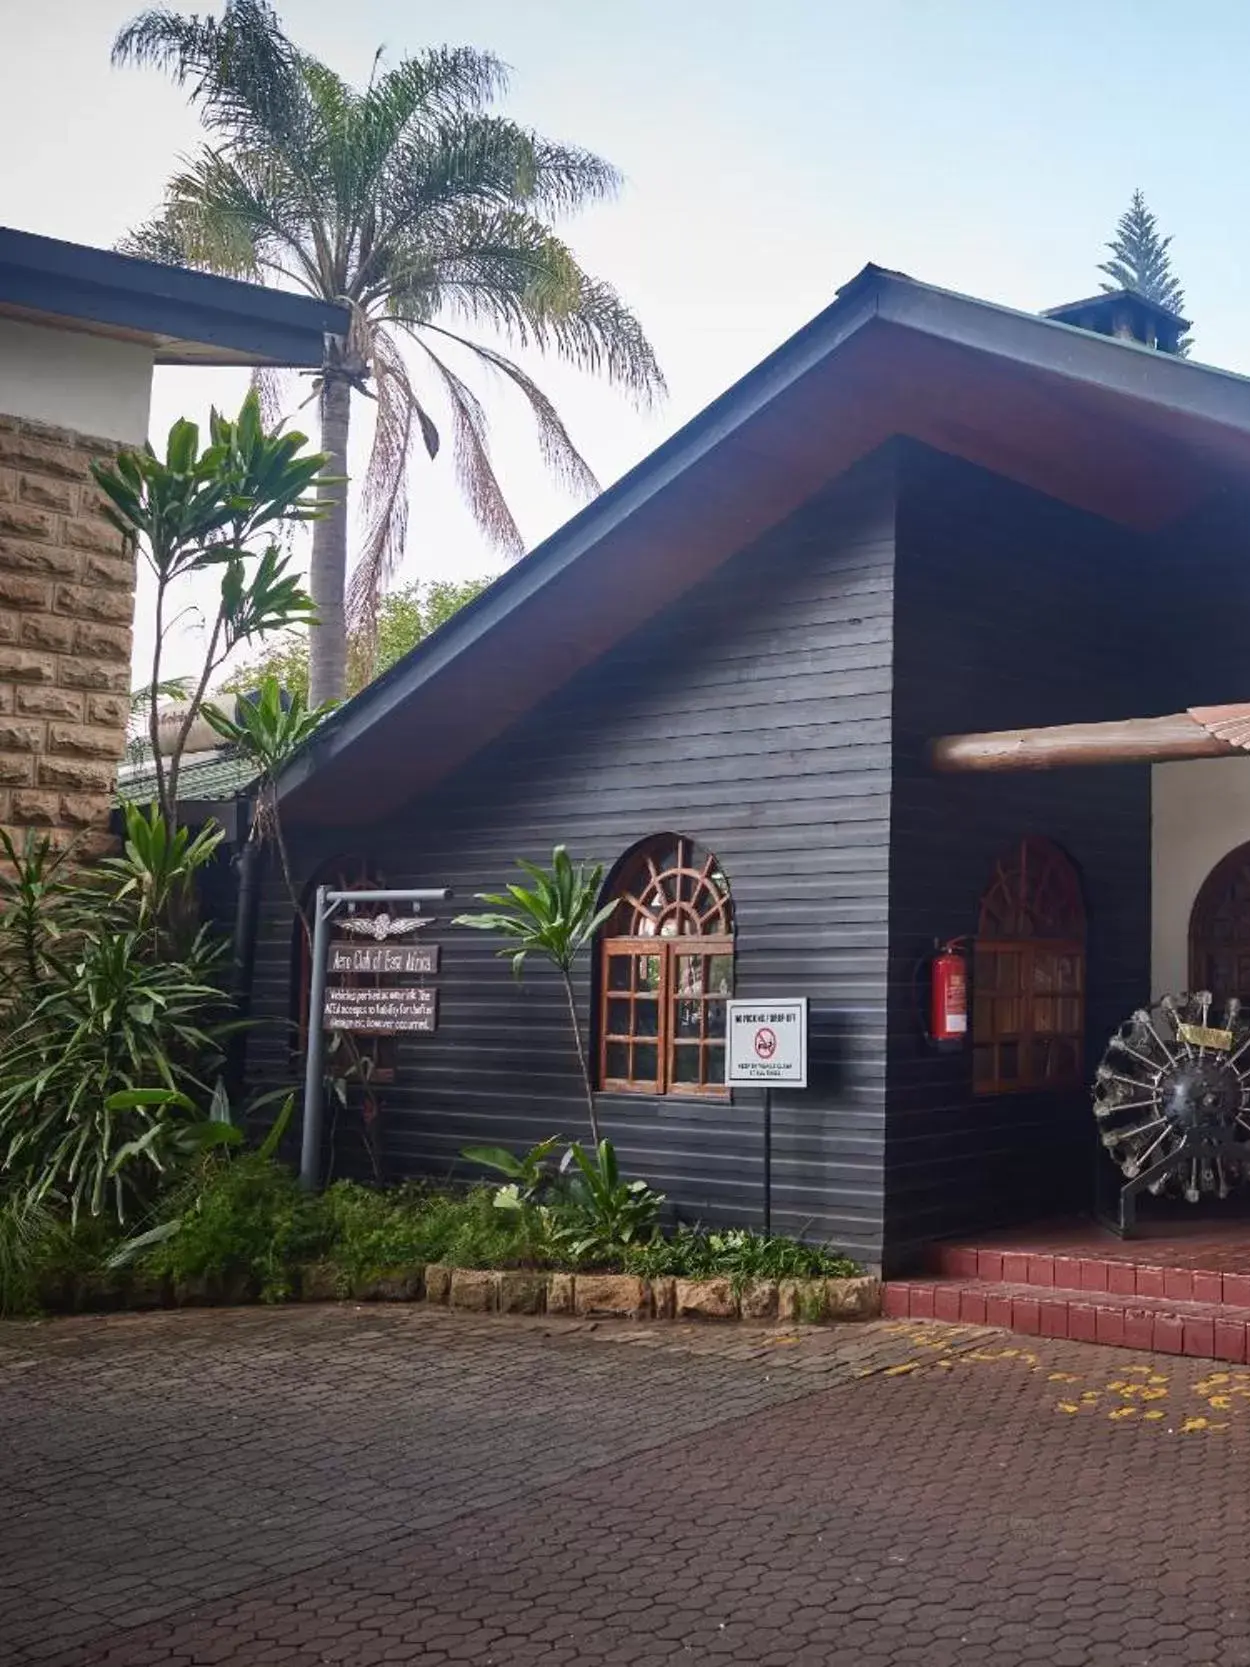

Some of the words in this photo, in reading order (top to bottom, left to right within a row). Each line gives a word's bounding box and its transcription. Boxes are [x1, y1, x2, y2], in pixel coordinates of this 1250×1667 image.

[333, 950, 352, 970] Aero
[353, 950, 371, 970] Club
[372, 950, 383, 970] of
[385, 950, 403, 972] East
[405, 951, 431, 972] Africa
